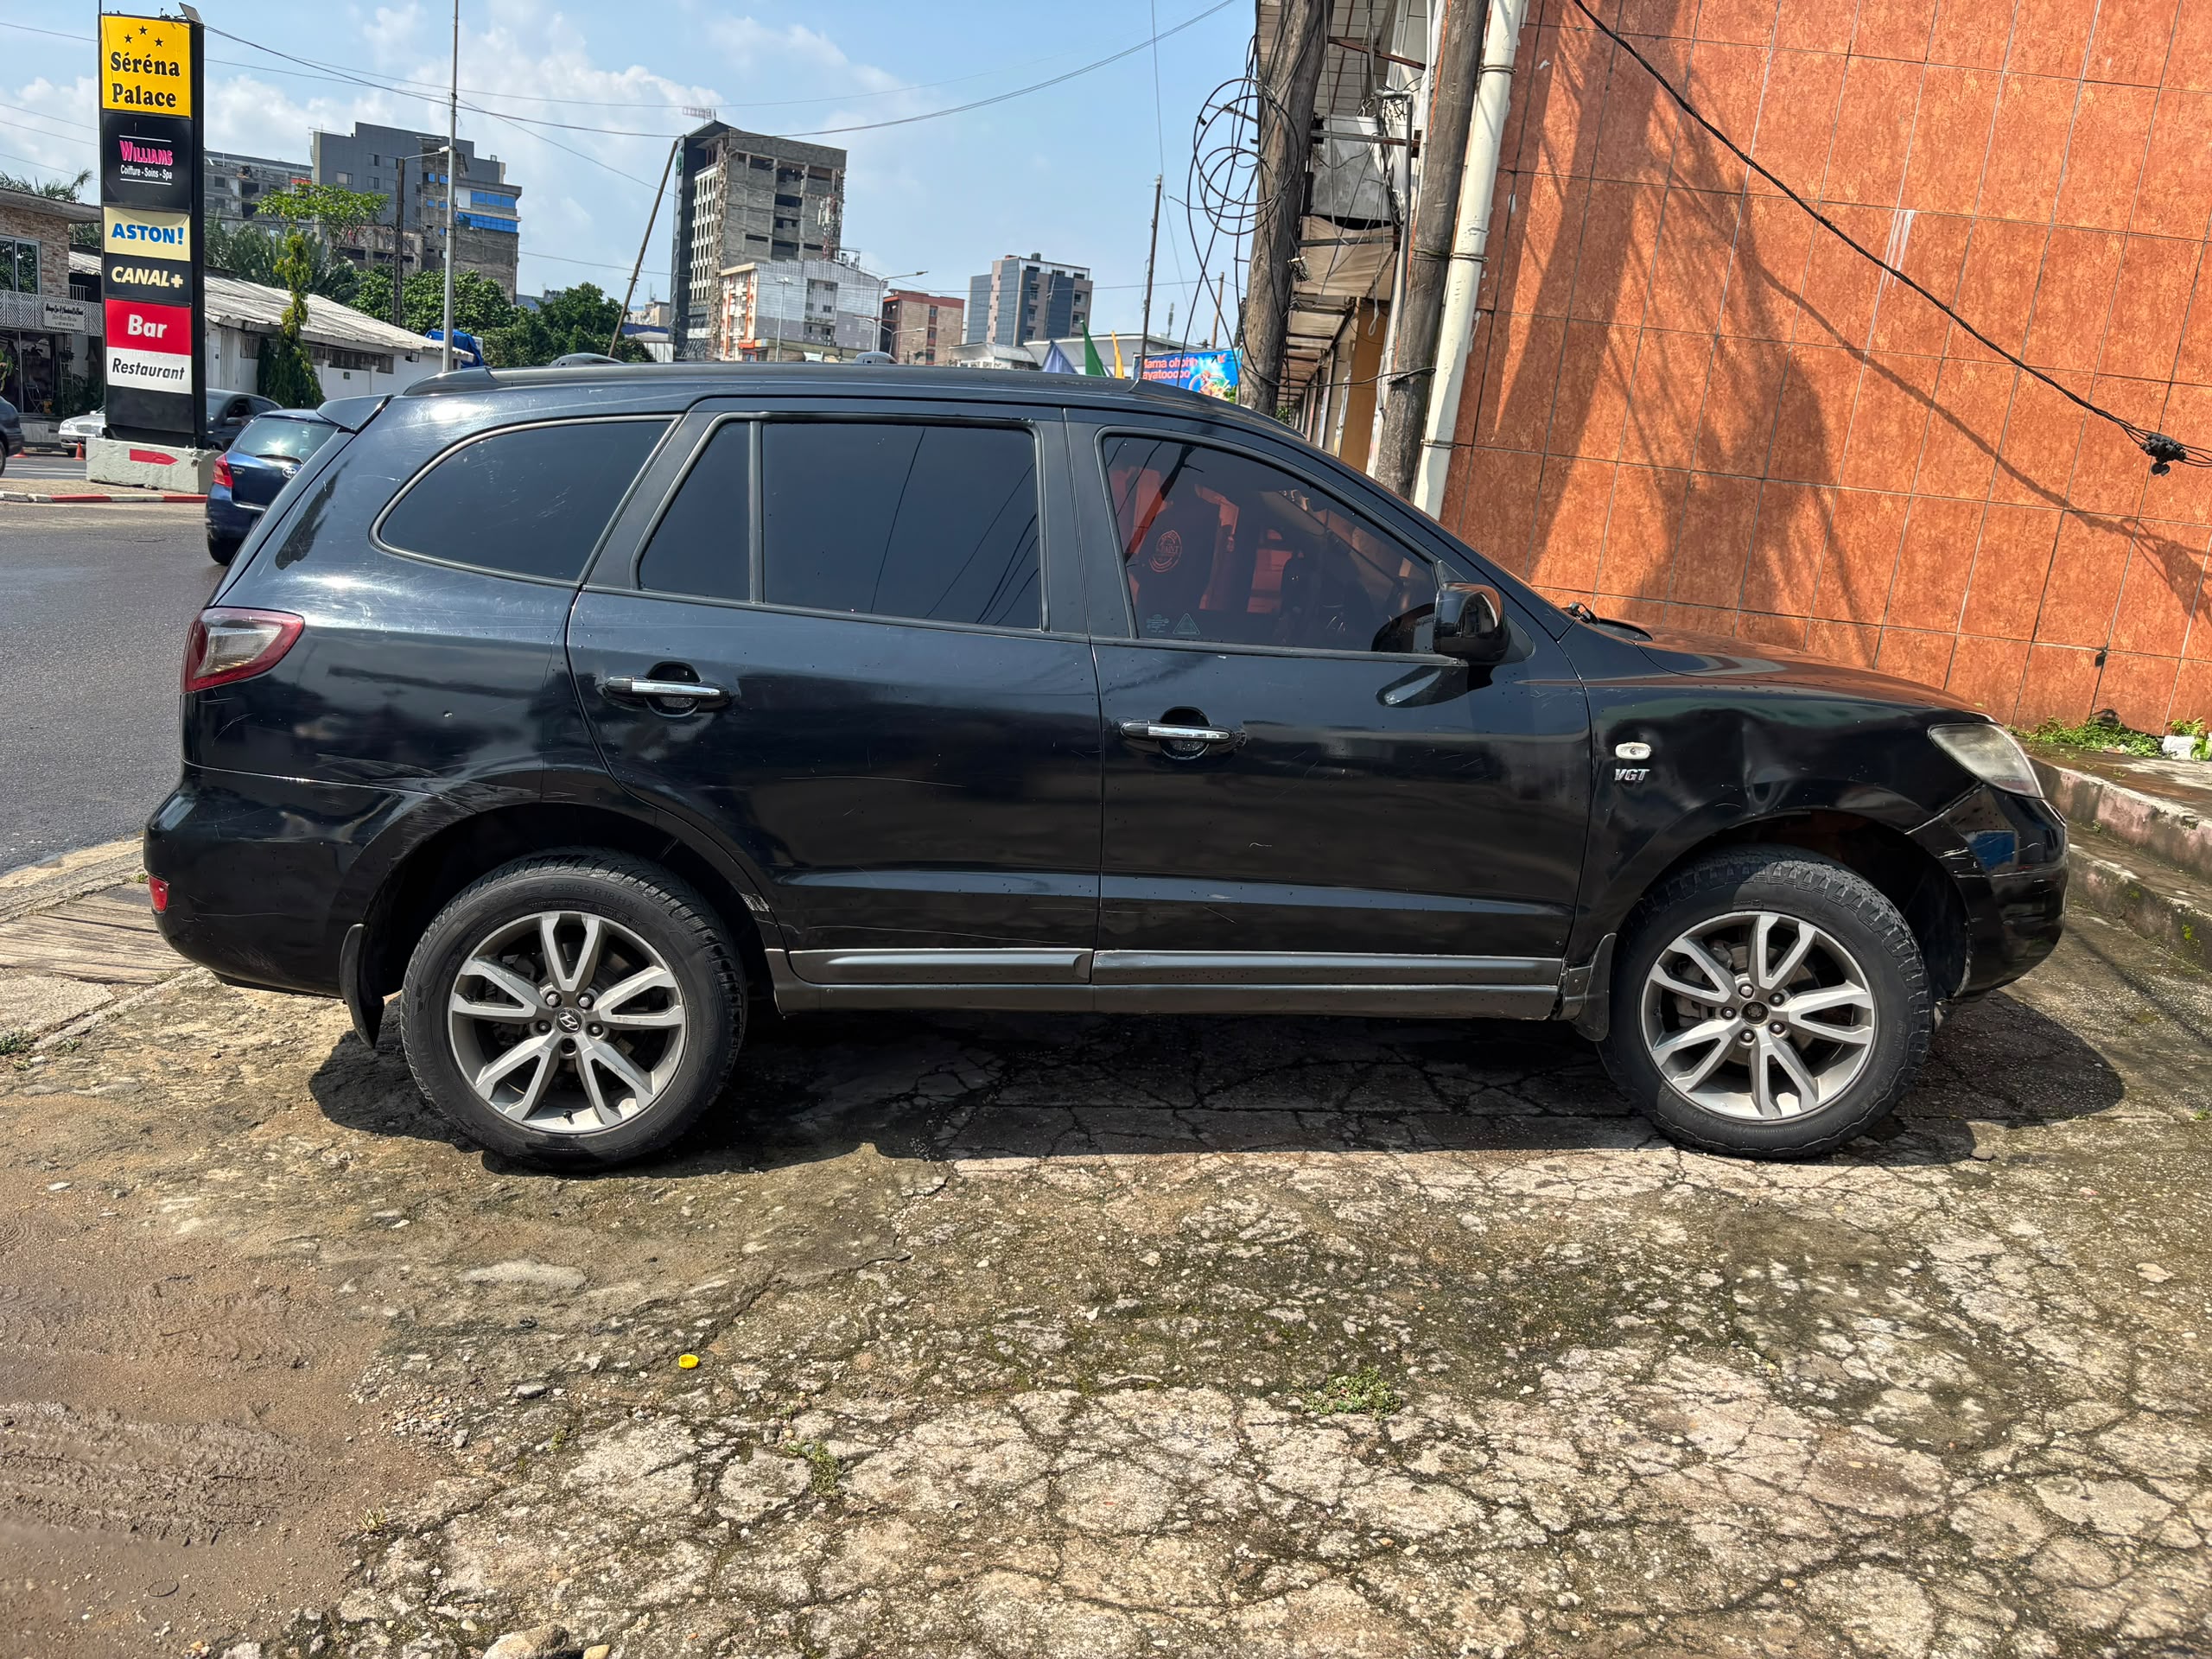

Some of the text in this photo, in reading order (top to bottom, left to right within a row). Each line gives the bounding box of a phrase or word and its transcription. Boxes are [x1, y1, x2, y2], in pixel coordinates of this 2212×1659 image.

[111, 52, 180, 77] Séréna
[111, 83, 176, 108] Palace
[119, 140, 173, 166] WILLIAMS
[120, 164, 141, 176] Coiffure
[144, 167, 159, 178] Soins
[162, 168, 173, 181] Spa
[111, 223, 184, 245] ASTON!
[111, 266, 183, 288] CANAL+
[127, 314, 168, 338] Bar
[112, 358, 185, 380] Restaurant
[1614, 768, 1650, 781] VGT
